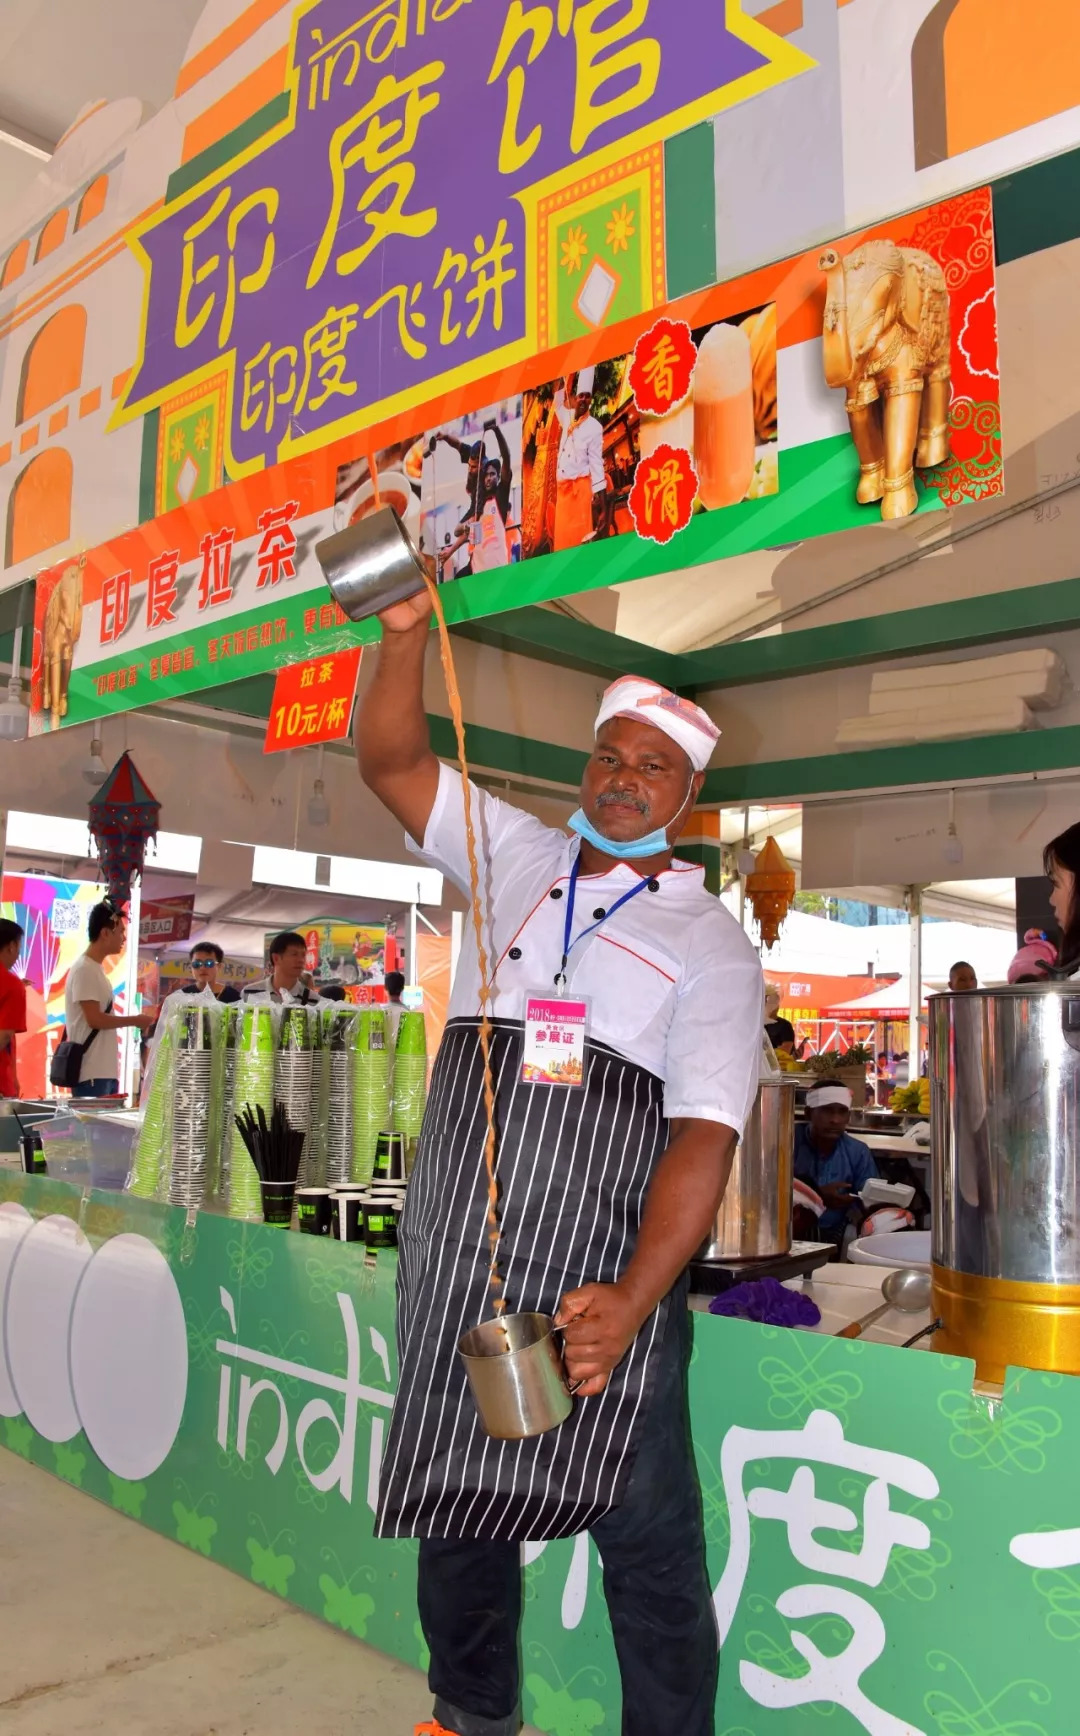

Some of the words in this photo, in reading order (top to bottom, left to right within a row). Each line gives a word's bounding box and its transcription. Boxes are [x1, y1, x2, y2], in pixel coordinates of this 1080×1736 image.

[174, 0, 662, 348] 印度馆
[240, 218, 517, 433] 印度飞饼
[641, 334, 681, 401] 香
[643, 458, 685, 527] 滑
[100, 502, 299, 645] 印度拉茶
[300, 661, 335, 688] 拉茶
[276, 698, 347, 739] 10元/杯
[535, 1030, 575, 1044] 参展证
